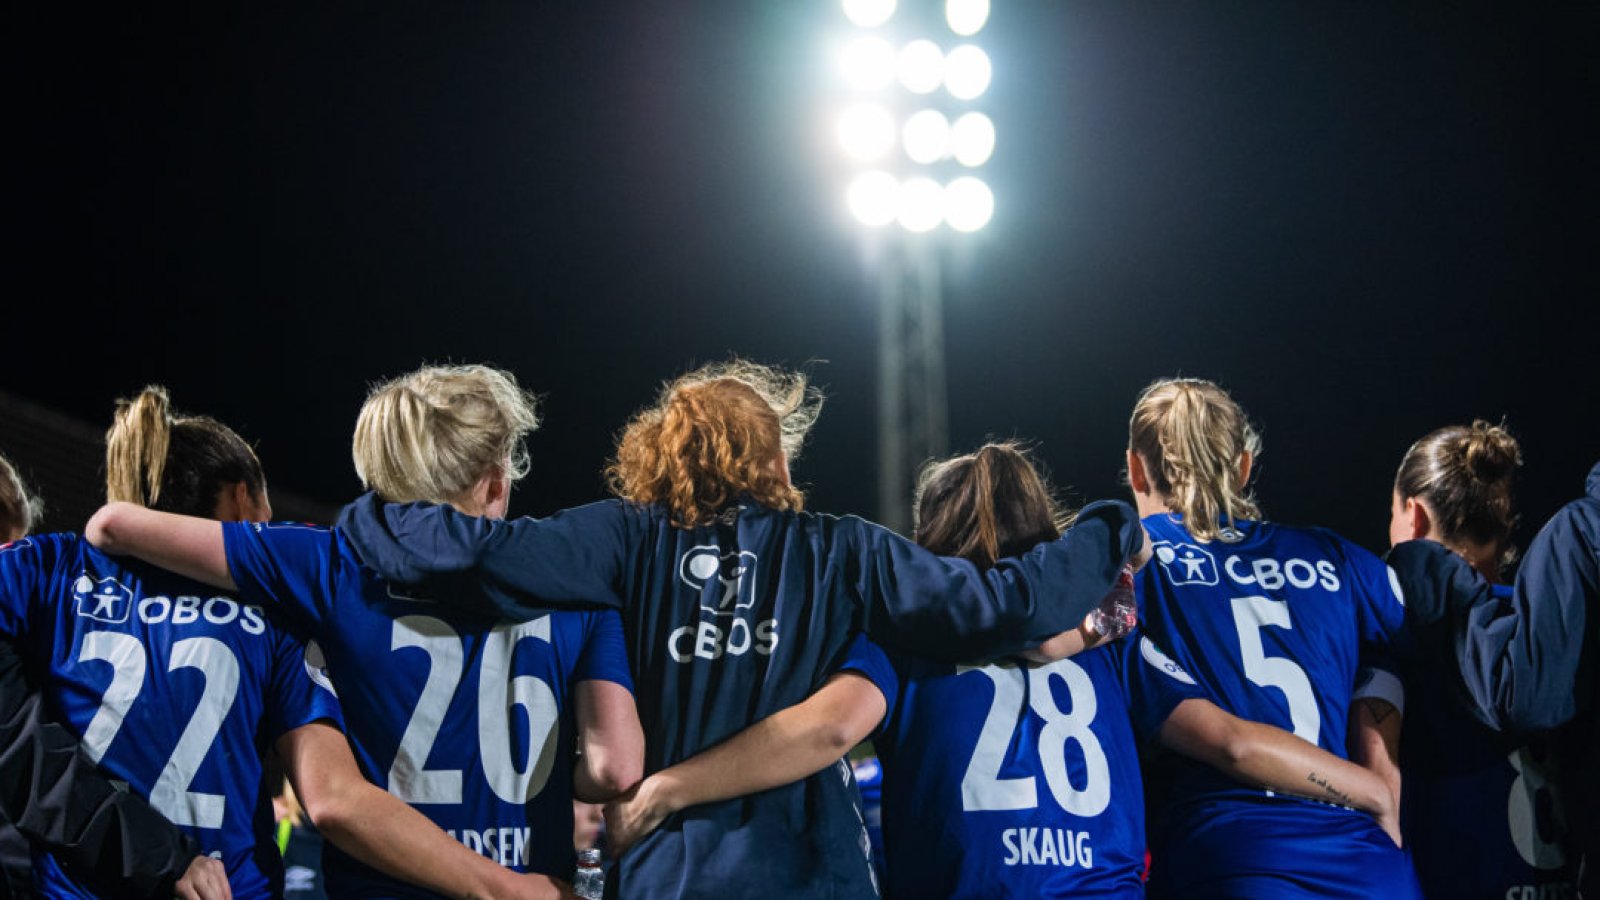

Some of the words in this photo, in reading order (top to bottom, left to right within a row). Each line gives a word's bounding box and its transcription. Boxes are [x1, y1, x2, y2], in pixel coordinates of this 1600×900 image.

[138, 596, 266, 635] OBOS
[1230, 597, 1321, 746] 5
[79, 631, 241, 828] 22
[389, 614, 557, 804] 26
[957, 659, 1110, 817] 28
[1002, 828, 1093, 869] SKAUG
